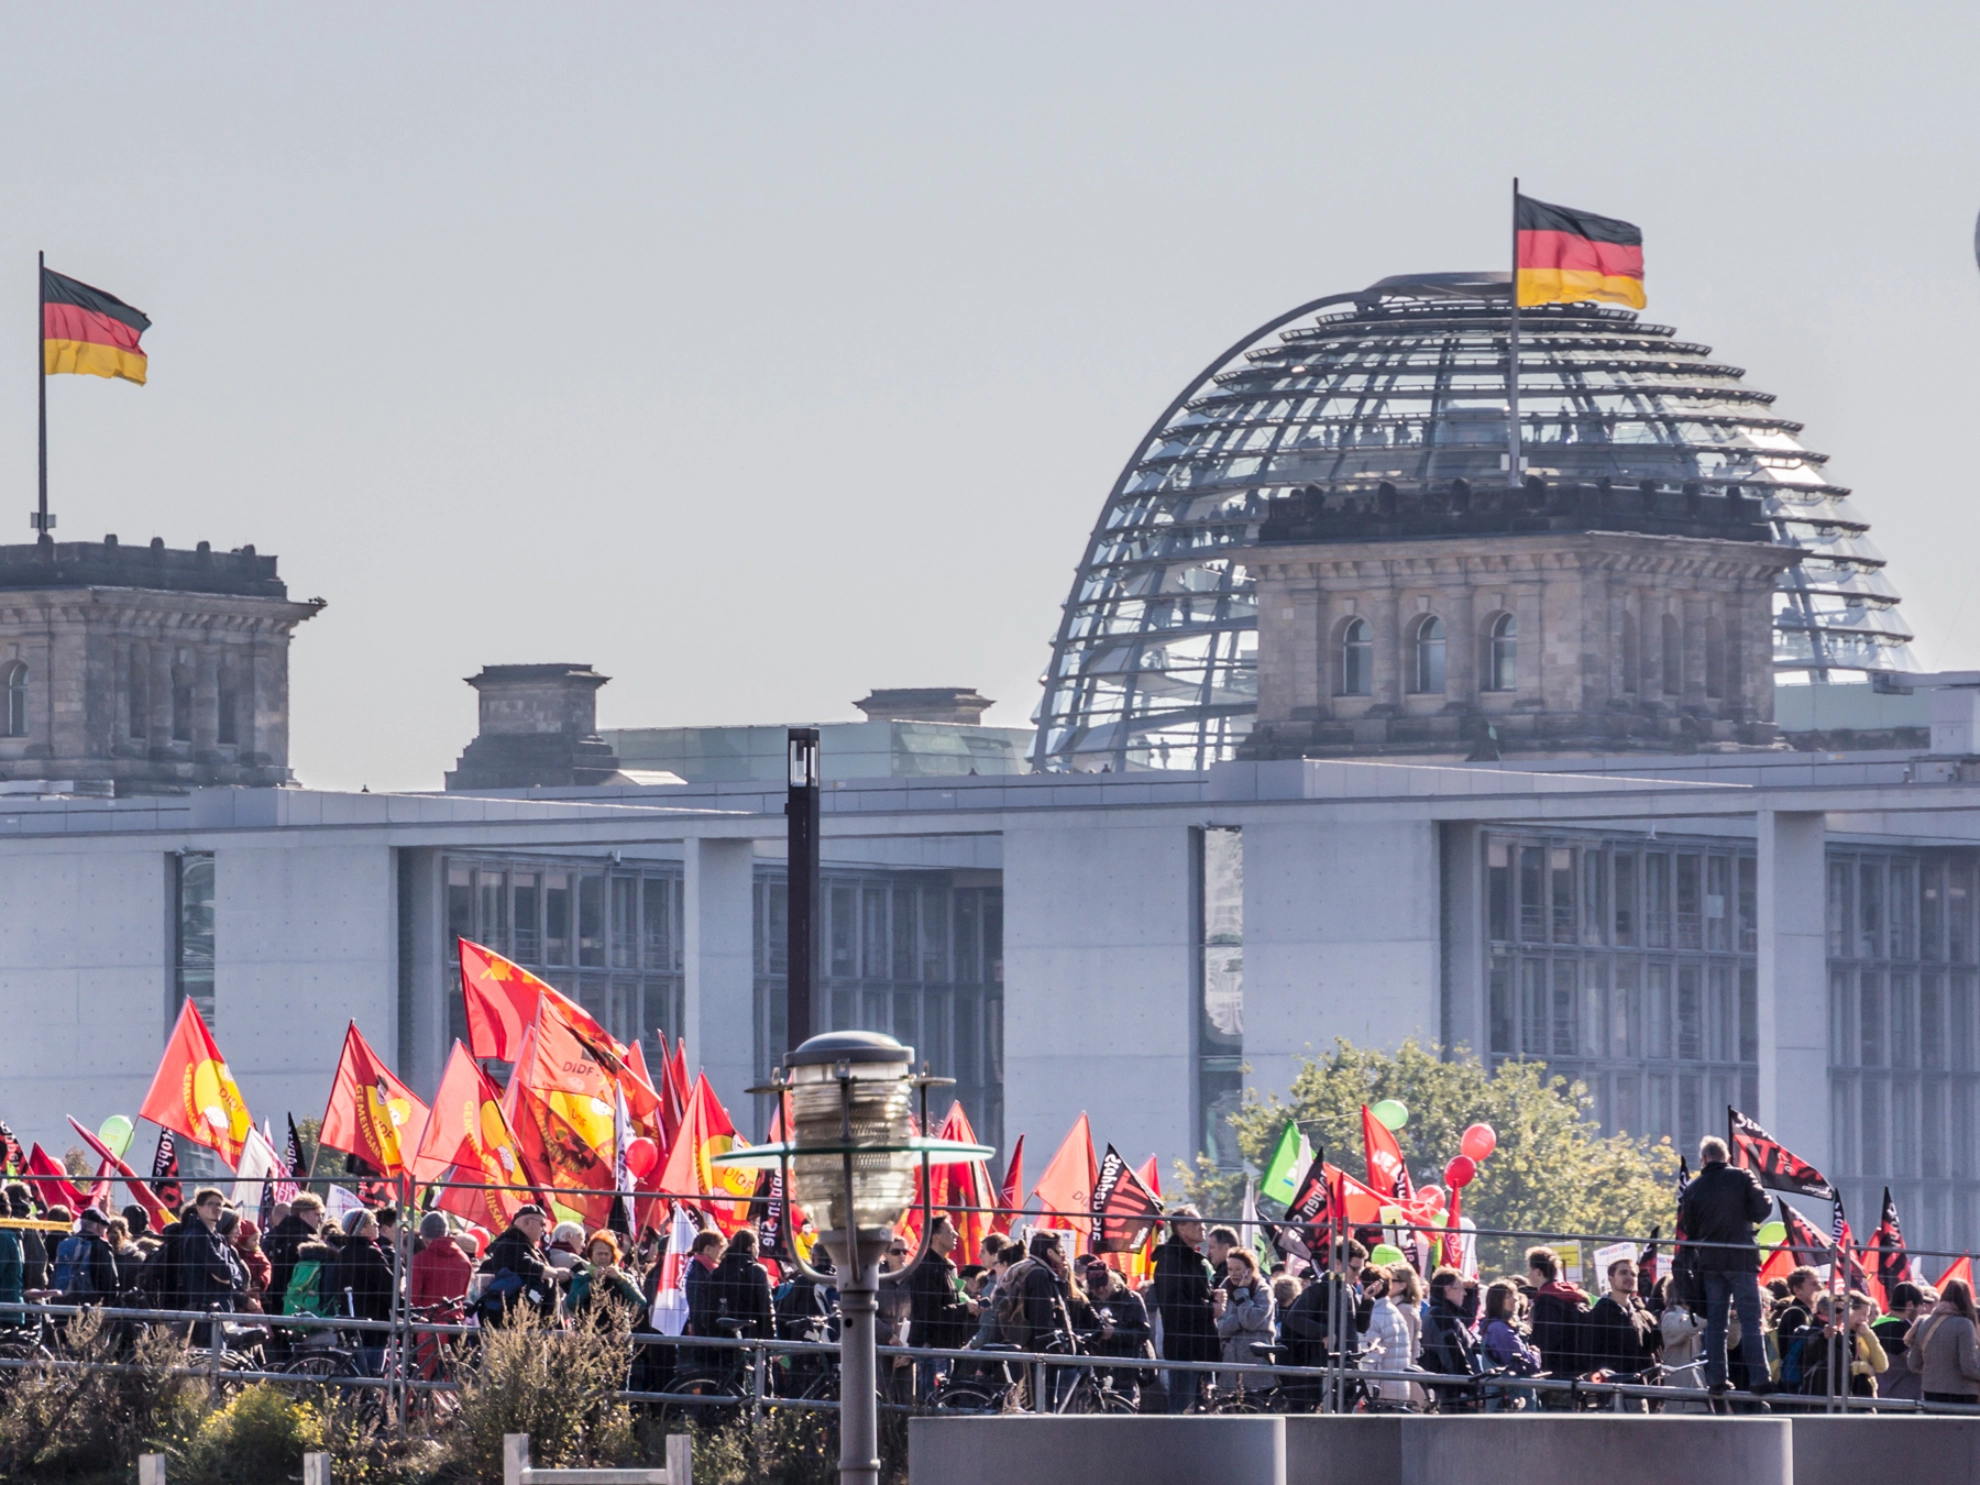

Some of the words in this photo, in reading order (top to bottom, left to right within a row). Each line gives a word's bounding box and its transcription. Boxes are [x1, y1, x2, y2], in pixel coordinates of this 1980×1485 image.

[562, 1060, 594, 1077] DIDF
[218, 1087, 246, 1114] DIDF
[355, 1083, 383, 1160] GEMEINSAM
[723, 1166, 756, 1193] DIDF
